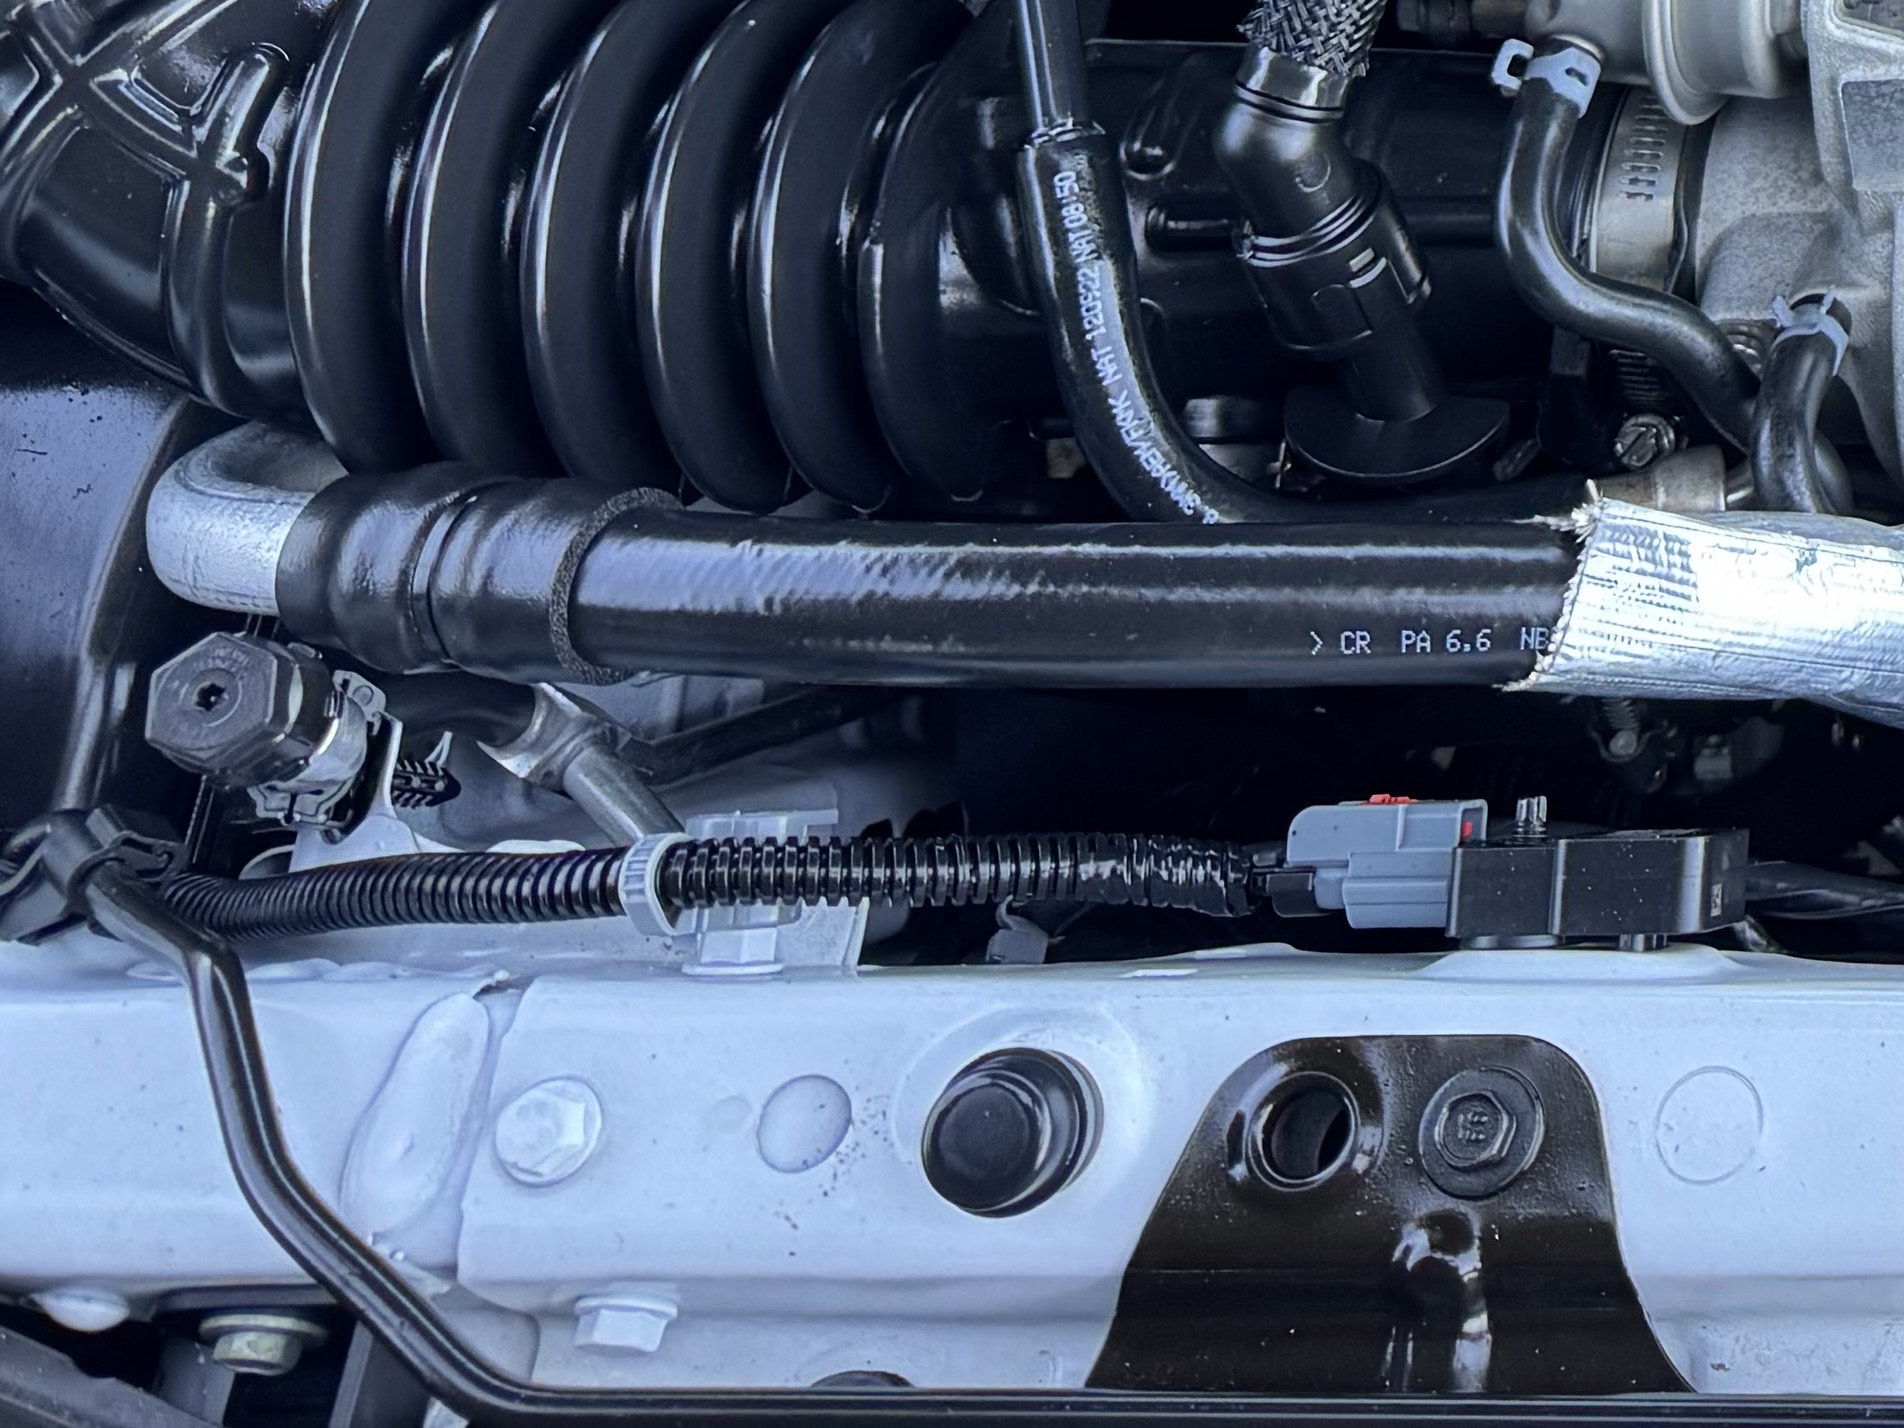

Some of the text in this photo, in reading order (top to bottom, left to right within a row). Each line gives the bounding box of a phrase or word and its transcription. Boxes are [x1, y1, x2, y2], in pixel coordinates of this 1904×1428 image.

[1090, 345, 1123, 386] NAT
[1340, 631, 1371, 654] CR
[1401, 630, 1431, 653] PA
